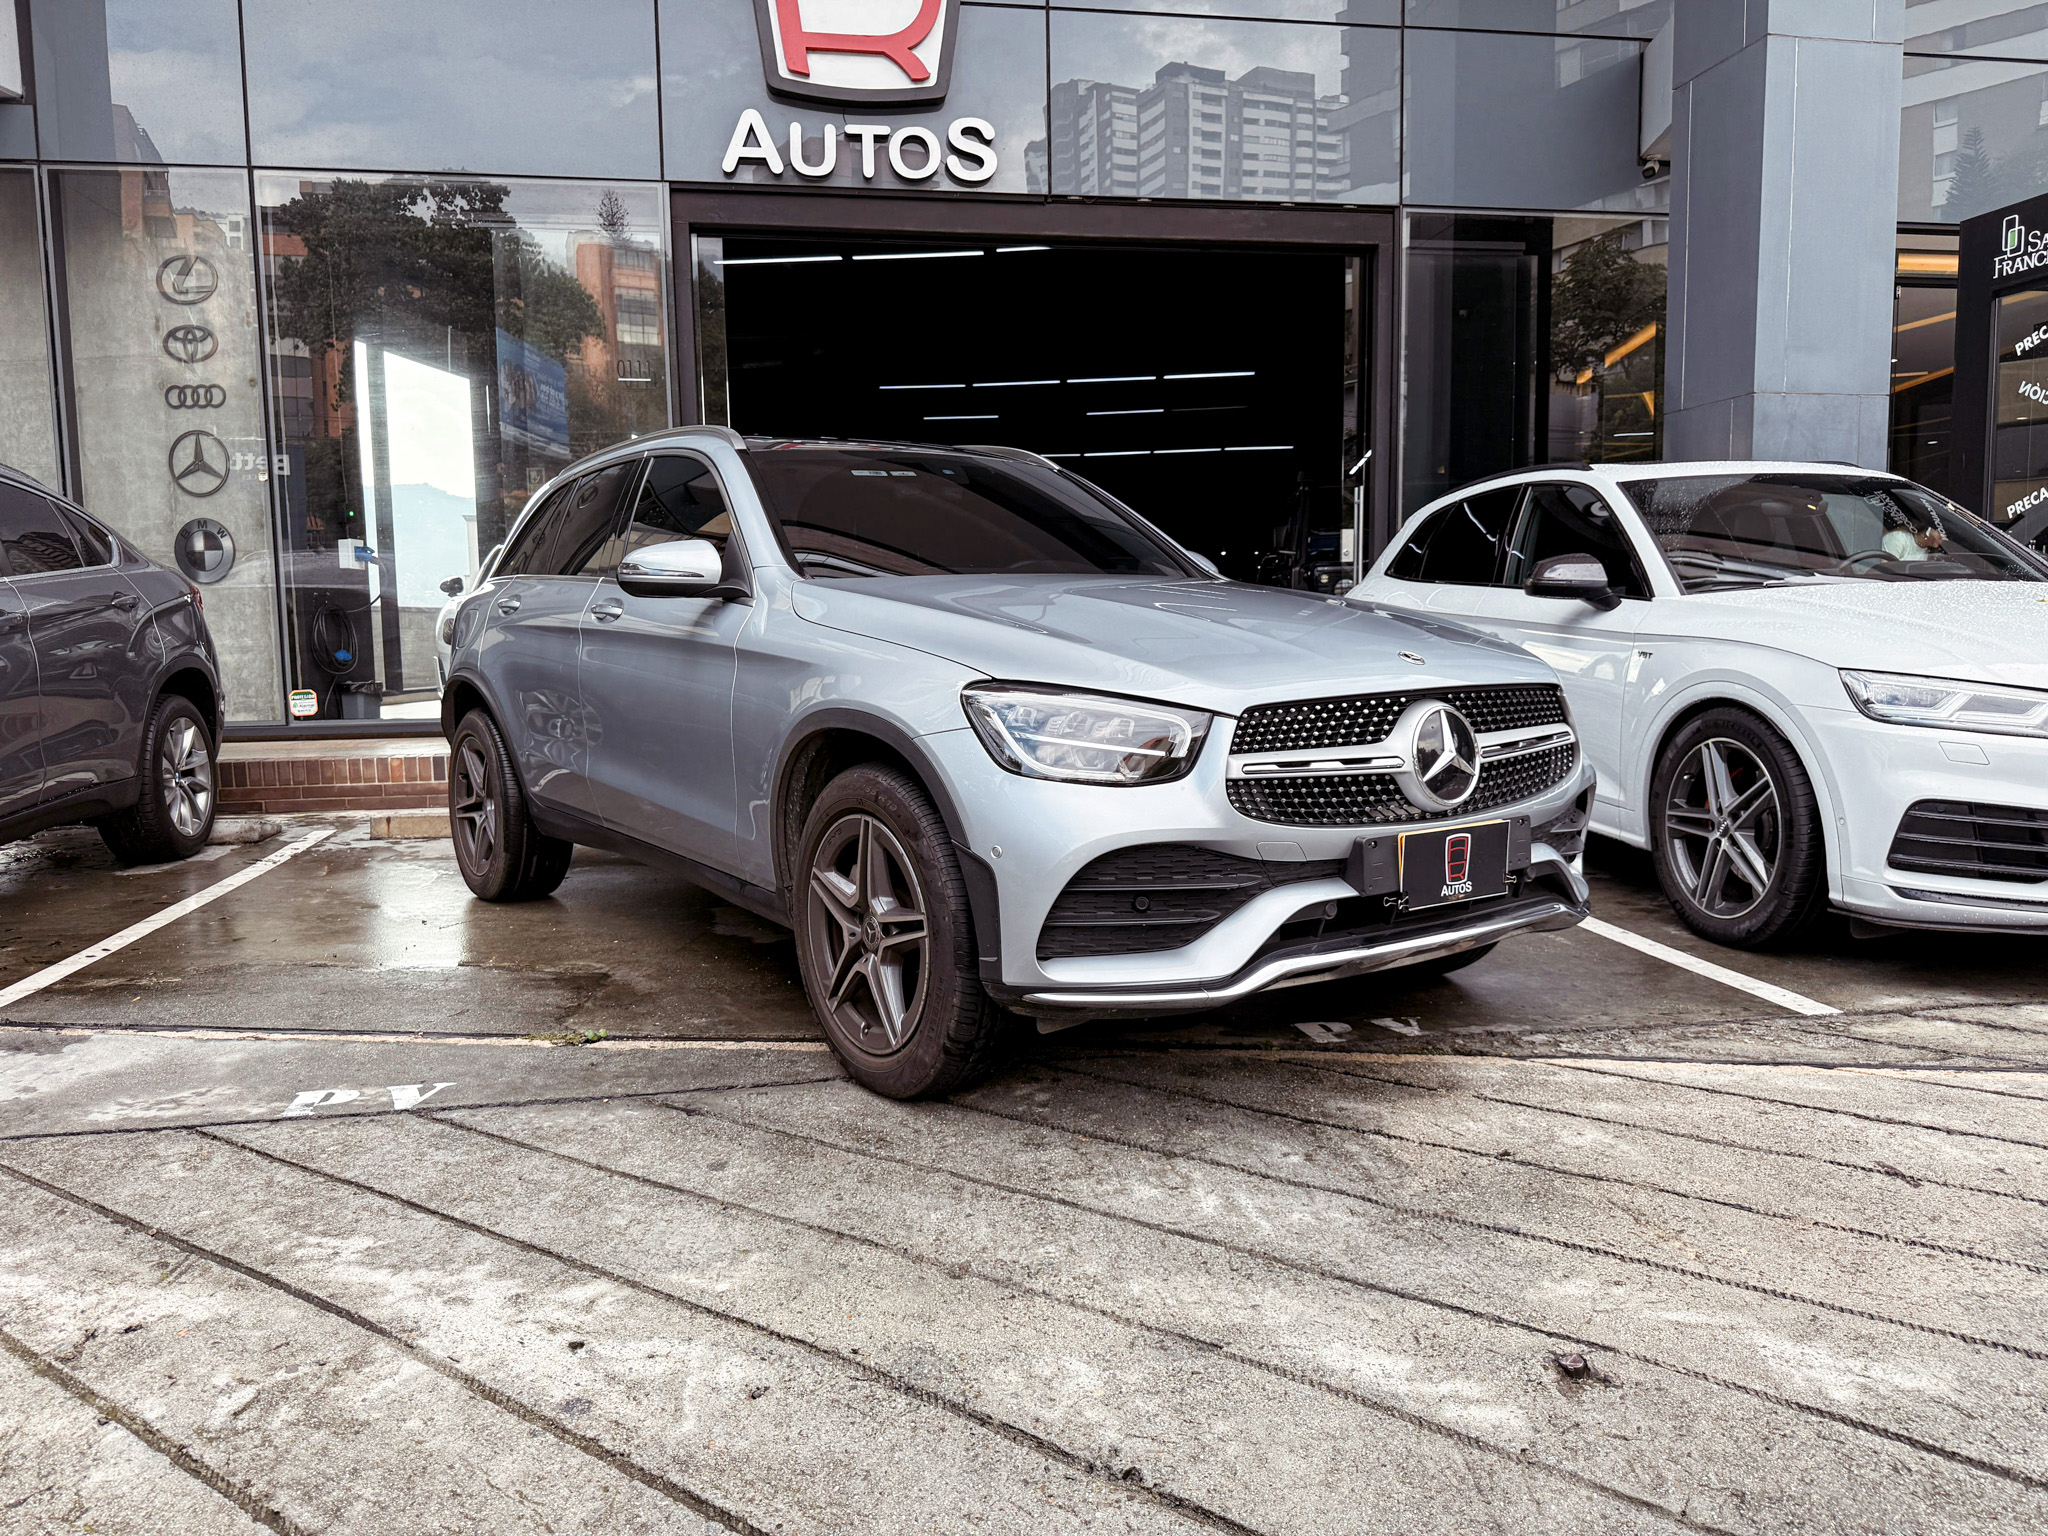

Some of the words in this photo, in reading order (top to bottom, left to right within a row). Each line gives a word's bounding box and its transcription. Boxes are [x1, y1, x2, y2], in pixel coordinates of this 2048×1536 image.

[721, 108, 998, 182] AUTOS
[180, 520, 227, 540] BMW
[1441, 881, 1473, 897] AUTOS
